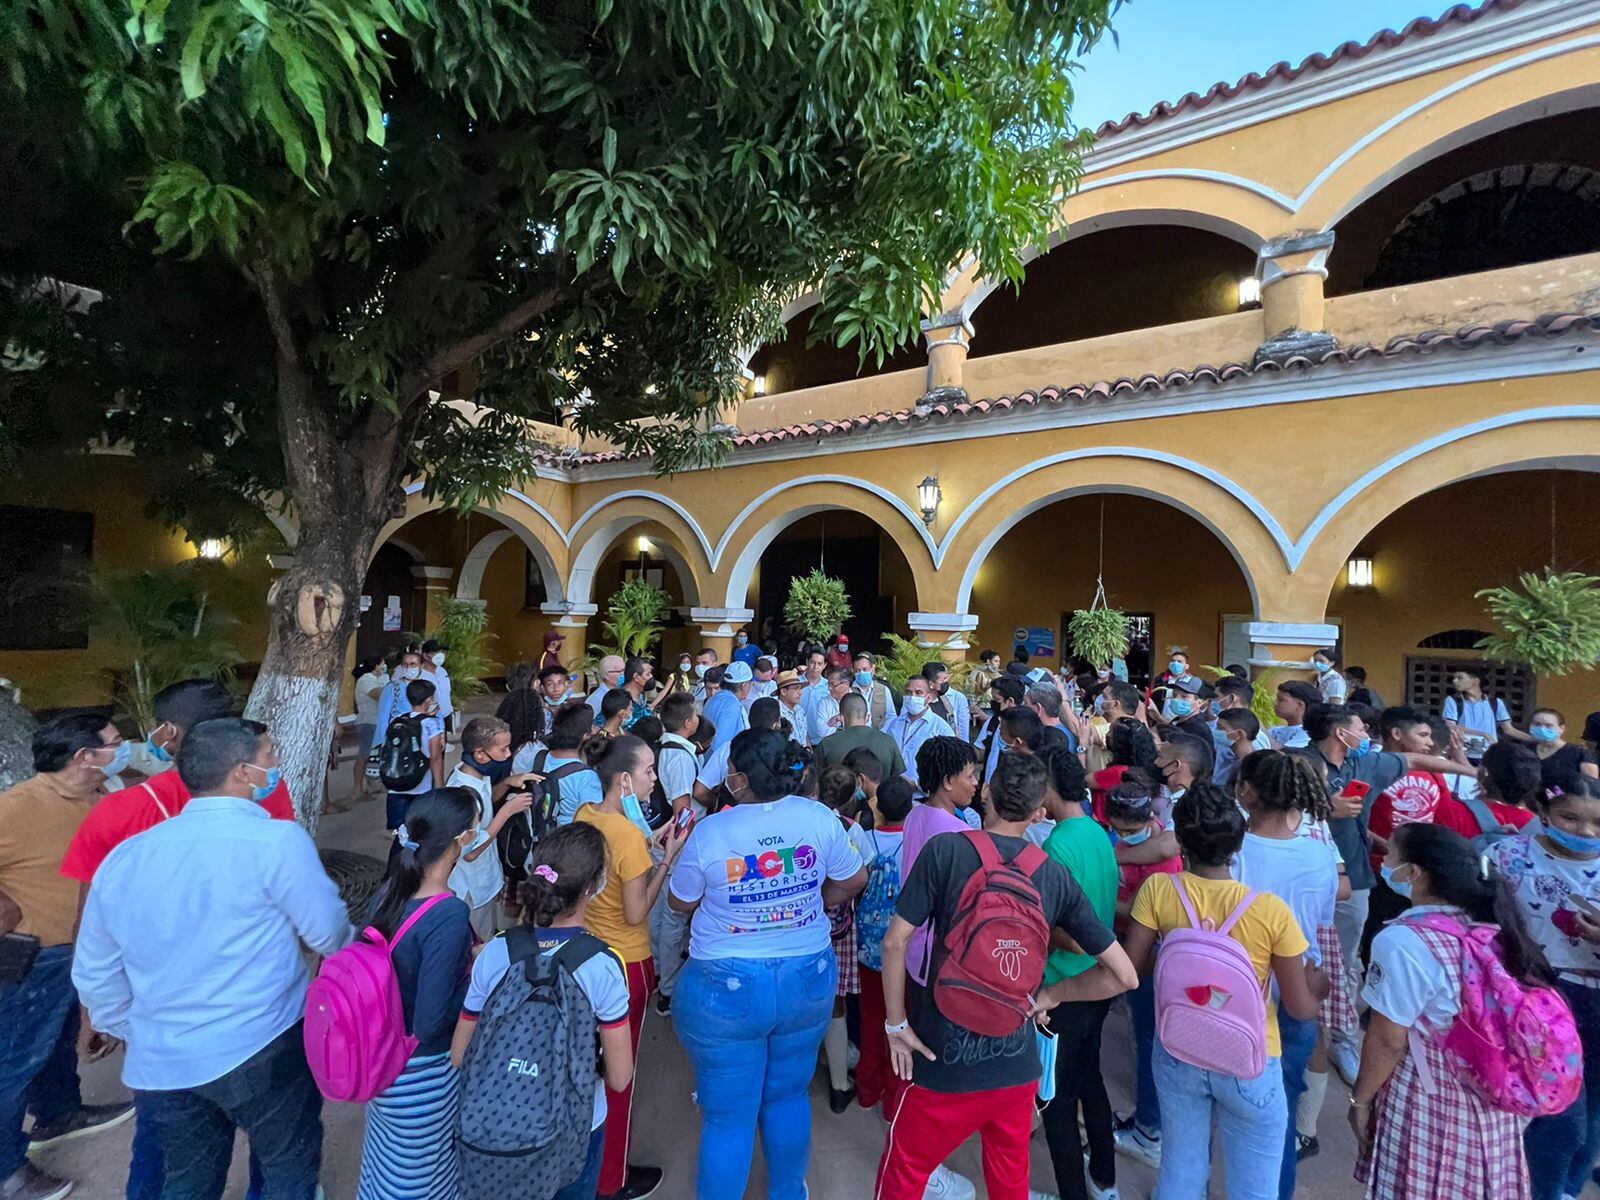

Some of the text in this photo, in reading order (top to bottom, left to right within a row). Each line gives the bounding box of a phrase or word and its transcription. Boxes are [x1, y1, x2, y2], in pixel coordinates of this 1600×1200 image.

[757, 836, 785, 847] VOTA
[726, 844, 817, 884] PACTO
[742, 895, 753, 903] EL
[767, 890, 778, 899] DE
[780, 883, 810, 896] MARZO
[996, 939, 1020, 947] TOTTO
[508, 1058, 539, 1077] FILA
